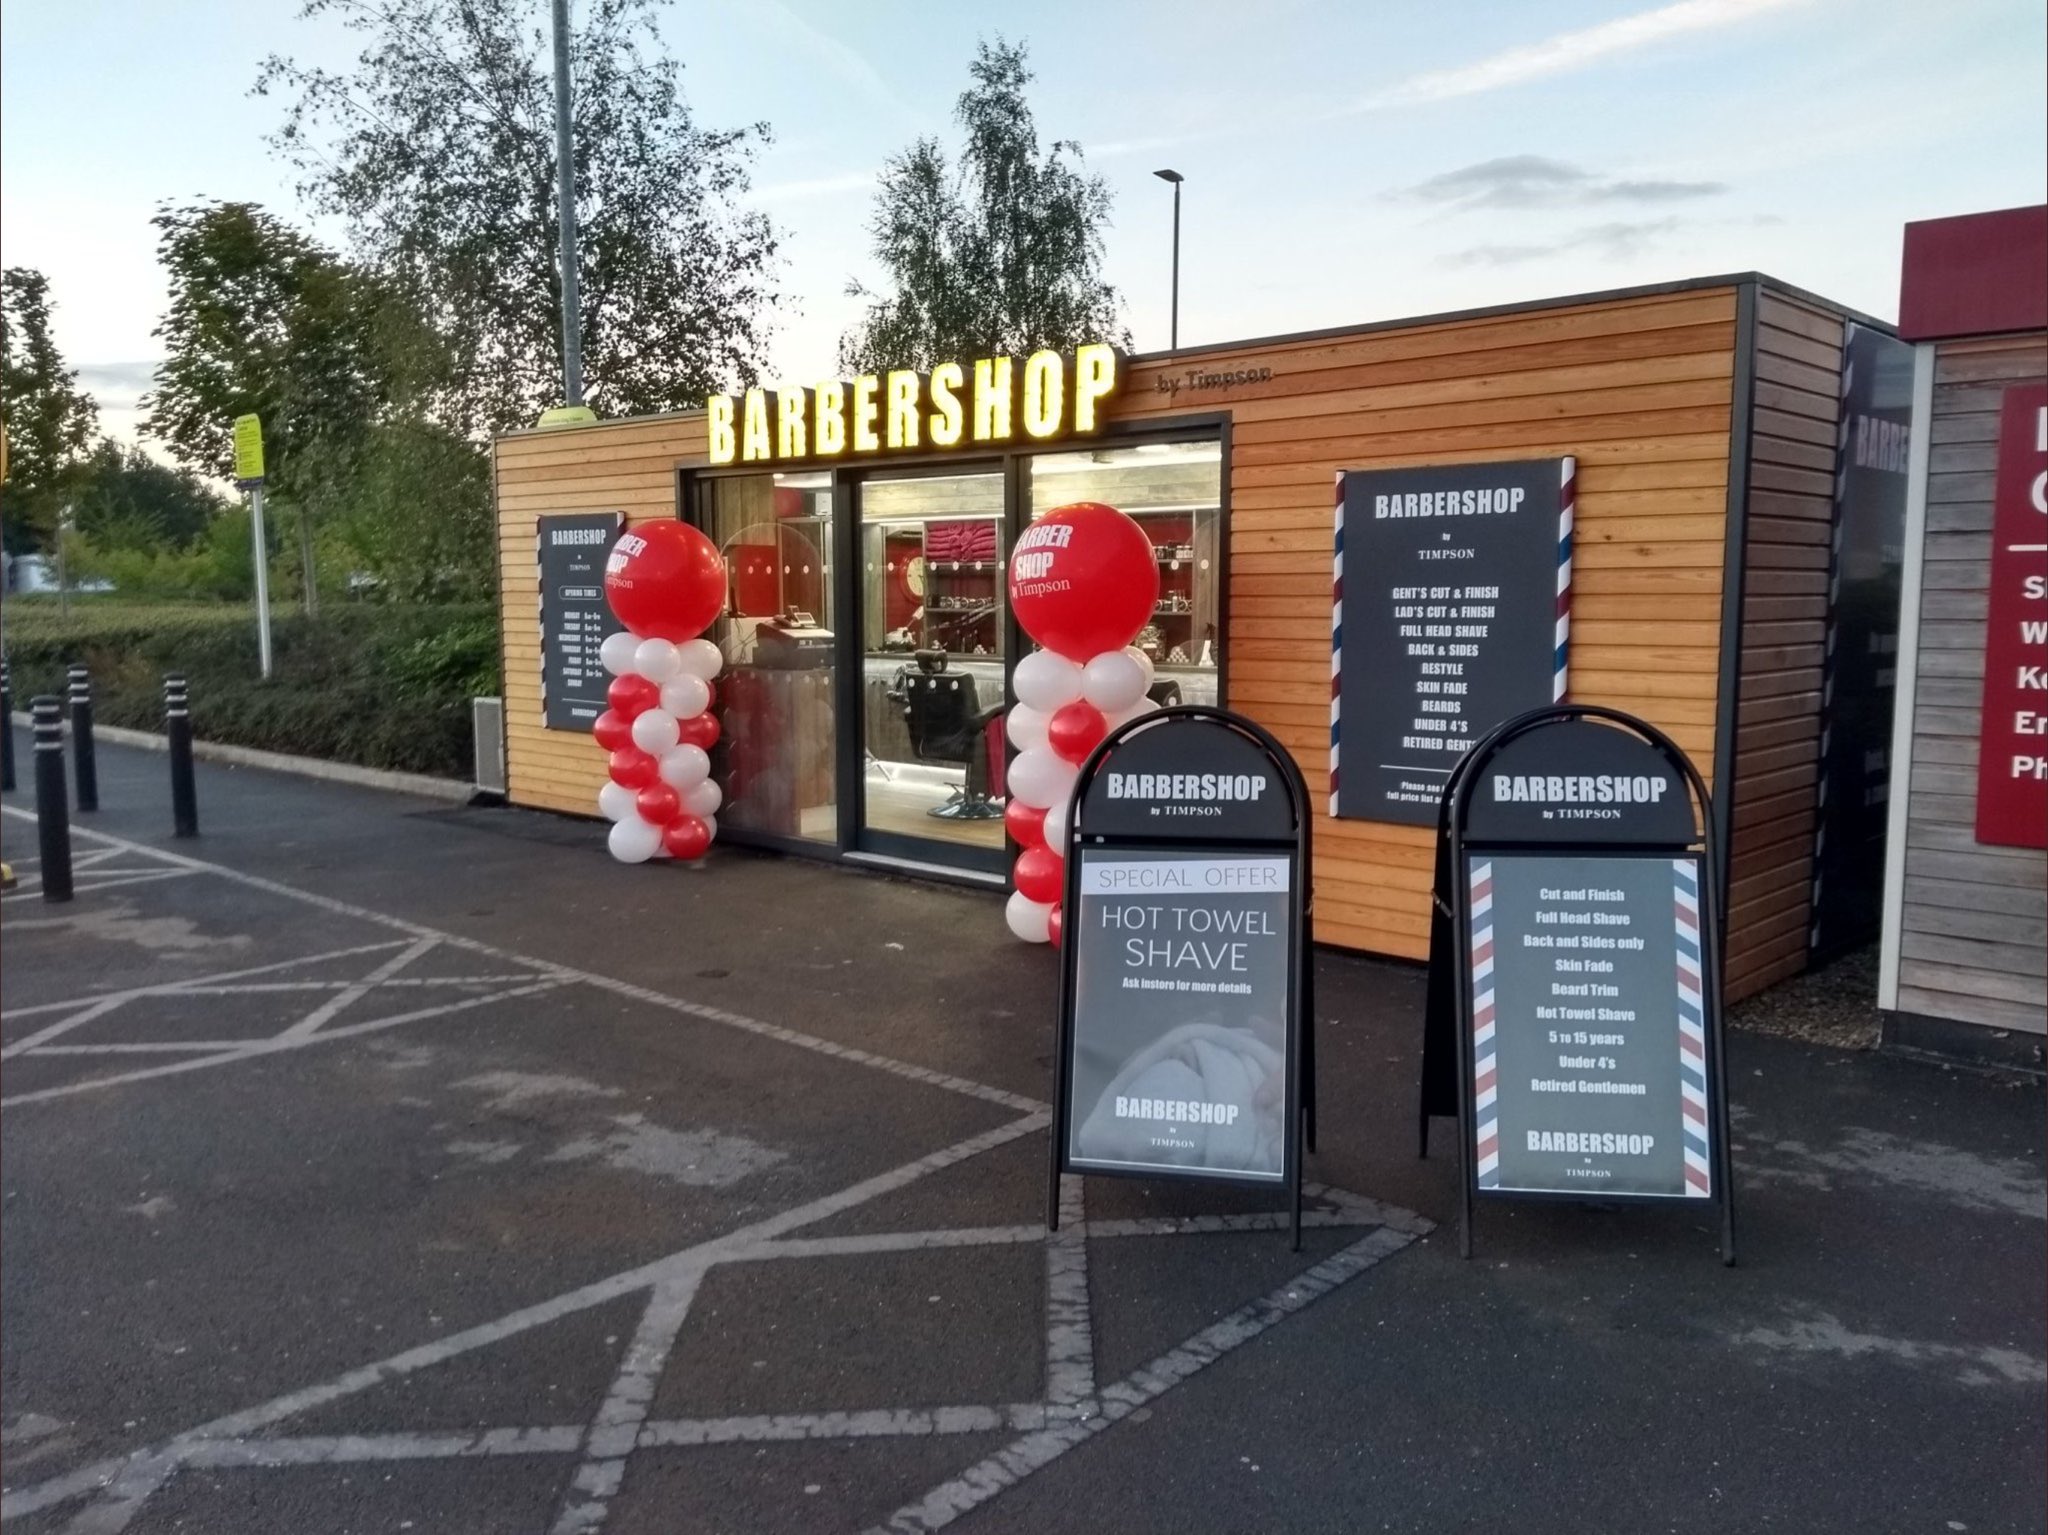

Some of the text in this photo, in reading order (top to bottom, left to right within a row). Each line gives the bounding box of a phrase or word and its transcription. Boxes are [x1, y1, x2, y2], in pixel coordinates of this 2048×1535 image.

[1154, 367, 1272, 397] by Timpson
[708, 343, 1116, 464] BARBERSHOP
[1375, 487, 1525, 518] BARBERSHOP
[552, 529, 606, 545] BARBERSHOP
[1442, 533, 1451, 541] by
[1418, 549, 1475, 560] TIMPSON
[1015, 552, 1054, 582] SHOP
[1018, 579, 1071, 598] Timpson
[1392, 586, 1499, 599] GENT'S CUT & FINISH
[1395, 606, 1495, 618] LAD'S CUT & FINISH
[1400, 625, 1488, 637] FULL HEAD SHAVE
[1408, 643, 1479, 656] BACK & SIDES
[1422, 662, 1463, 675] RESTYLE
[1417, 681, 1468, 694] SKIN FADE
[1422, 700, 1461, 713] BEARDS
[1414, 718, 1468, 733] UNDER 4'S
[1403, 736, 1443, 750] RETIRED
[1108, 773, 1266, 800] BARBERSHOP
[1401, 781, 1425, 791] Please
[1494, 775, 1667, 803] BARBERSHOP
[1387, 791, 1399, 800] full
[1401, 793, 1419, 802] price
[1421, 794, 1434, 803] list
[1151, 806, 1223, 816] by TIMPSON
[1543, 809, 1621, 819] by TIMPSON
[1099, 867, 1277, 888] SPECIAL OFFER
[1540, 888, 1625, 901] Cut and Finish
[1102, 905, 1276, 935] HOT TOWEL
[1536, 911, 1631, 925] Full Head Shave
[1524, 934, 1644, 950] Back and Sides only
[1126, 938, 1248, 971] SHAVE
[1555, 959, 1614, 973] Skin Fade
[1123, 977, 1140, 988] Ask
[1176, 980, 1190, 991] for
[1191, 982, 1217, 992] more
[1218, 982, 1252, 994] details
[1552, 983, 1619, 997] Beard Trim
[1537, 1006, 1636, 1021] Hot Towel Shave
[1549, 1031, 1558, 1043] 5
[1573, 1032, 1587, 1044] 15
[1589, 1033, 1625, 1046] years
[1559, 1055, 1616, 1070] Under 4's
[1531, 1079, 1646, 1095] Retired Gentlemen
[1116, 1096, 1239, 1125] BARBERSHOP
[1150, 1137, 1195, 1148] TIMPSON
[1527, 1130, 1655, 1155] BARBERSHOP
[1566, 1168, 1612, 1178] TIMPSON
